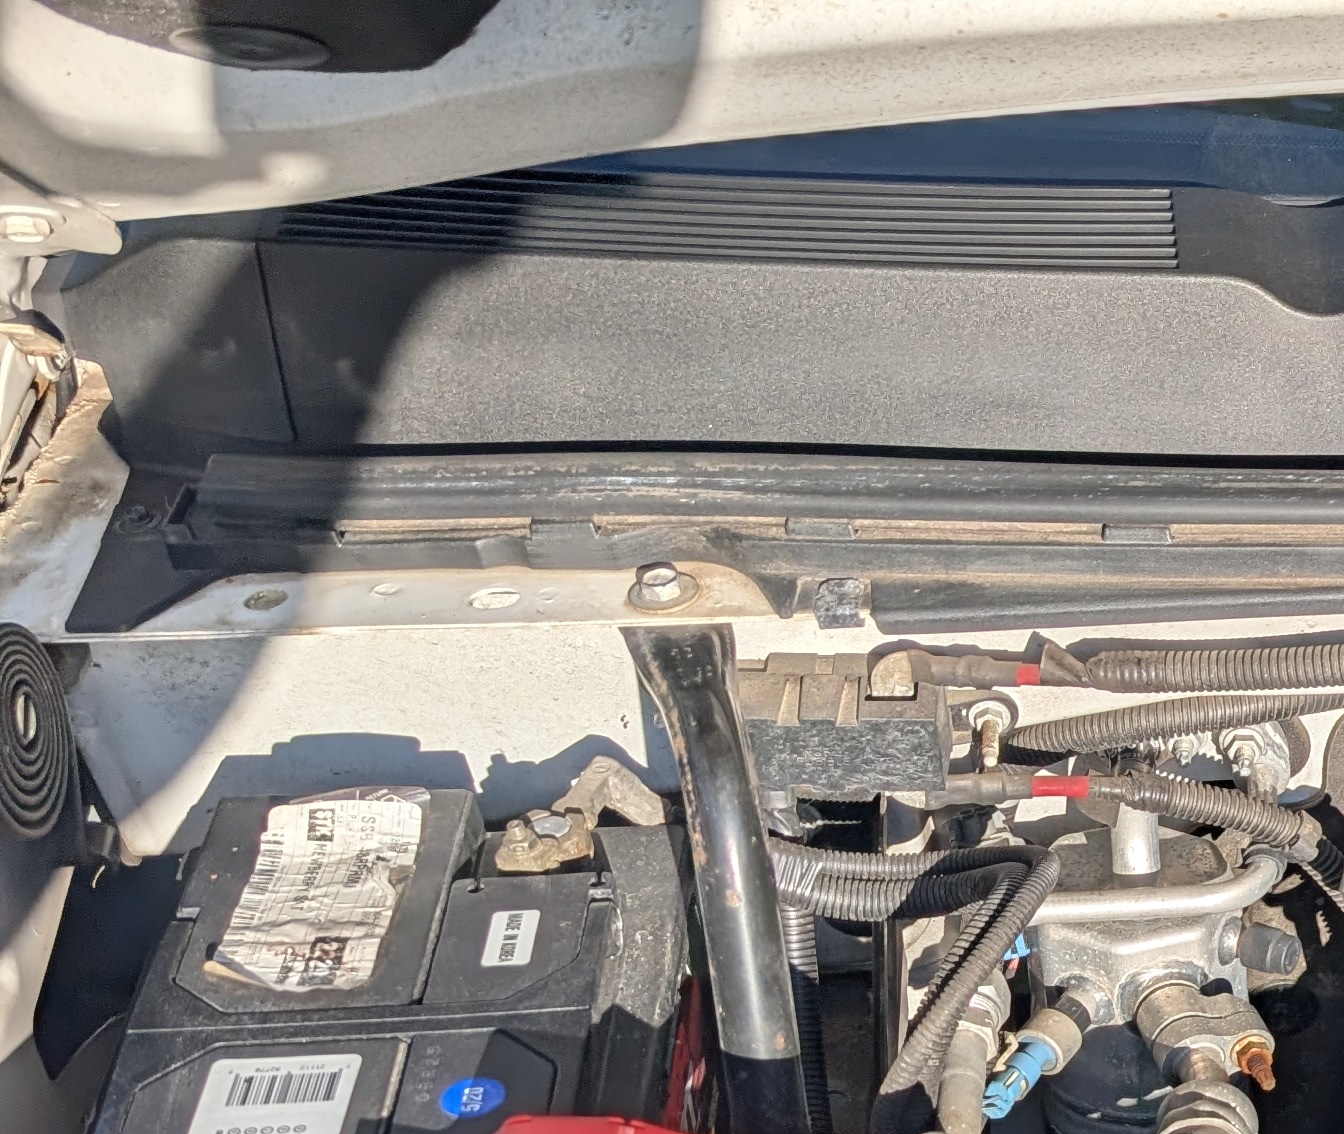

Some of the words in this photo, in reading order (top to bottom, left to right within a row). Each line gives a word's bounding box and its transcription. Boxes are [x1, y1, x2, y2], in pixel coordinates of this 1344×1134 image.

[505, 912, 524, 931] MADE
[502, 933, 519, 941] IN
[498, 942, 517, 963] KOREA
[460, 1086, 484, 1112] 5/20
